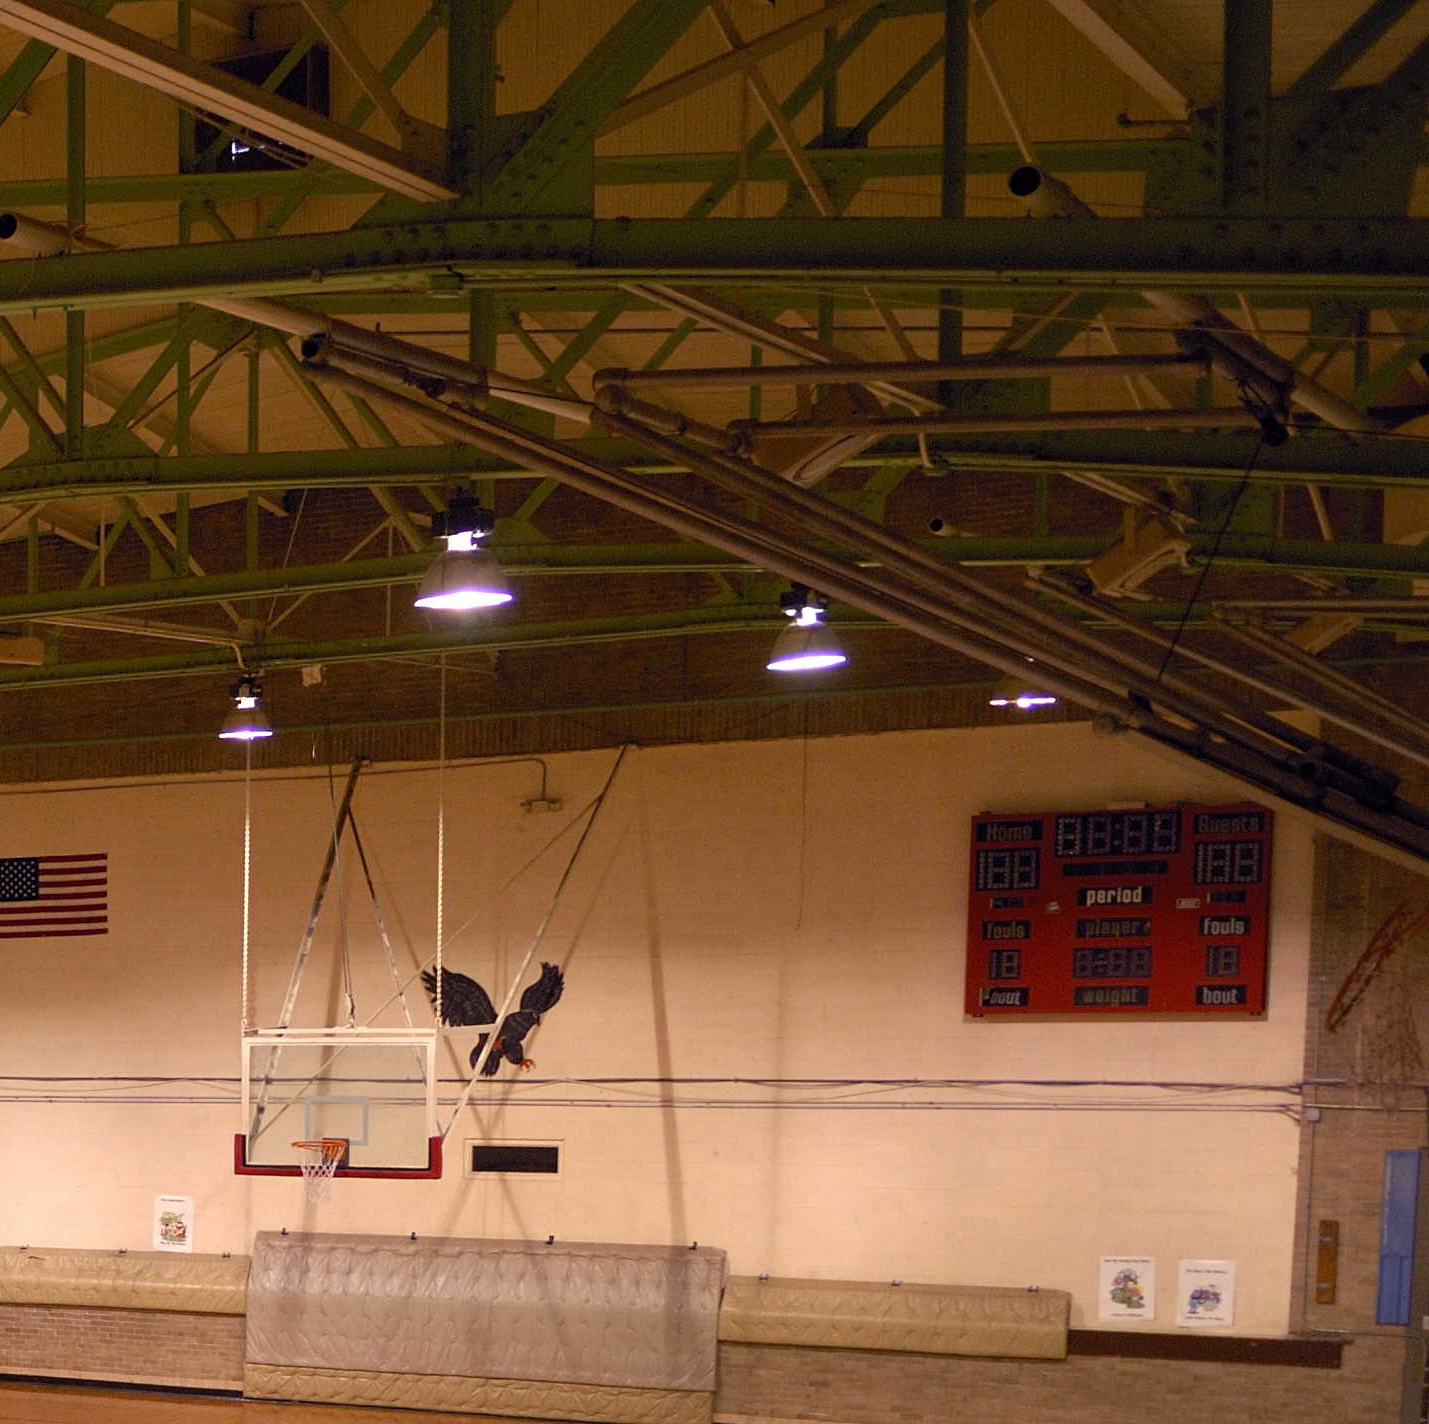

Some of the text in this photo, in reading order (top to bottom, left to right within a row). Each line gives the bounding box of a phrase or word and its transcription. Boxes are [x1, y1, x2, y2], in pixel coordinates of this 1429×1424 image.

[986, 822, 1034, 841] Home
[1198, 813, 1260, 833] Guests
[1086, 886, 1143, 907] period
[987, 921, 1026, 938] fouls
[1203, 917, 1245, 935] fouls
[1202, 986, 1239, 1005] bout
